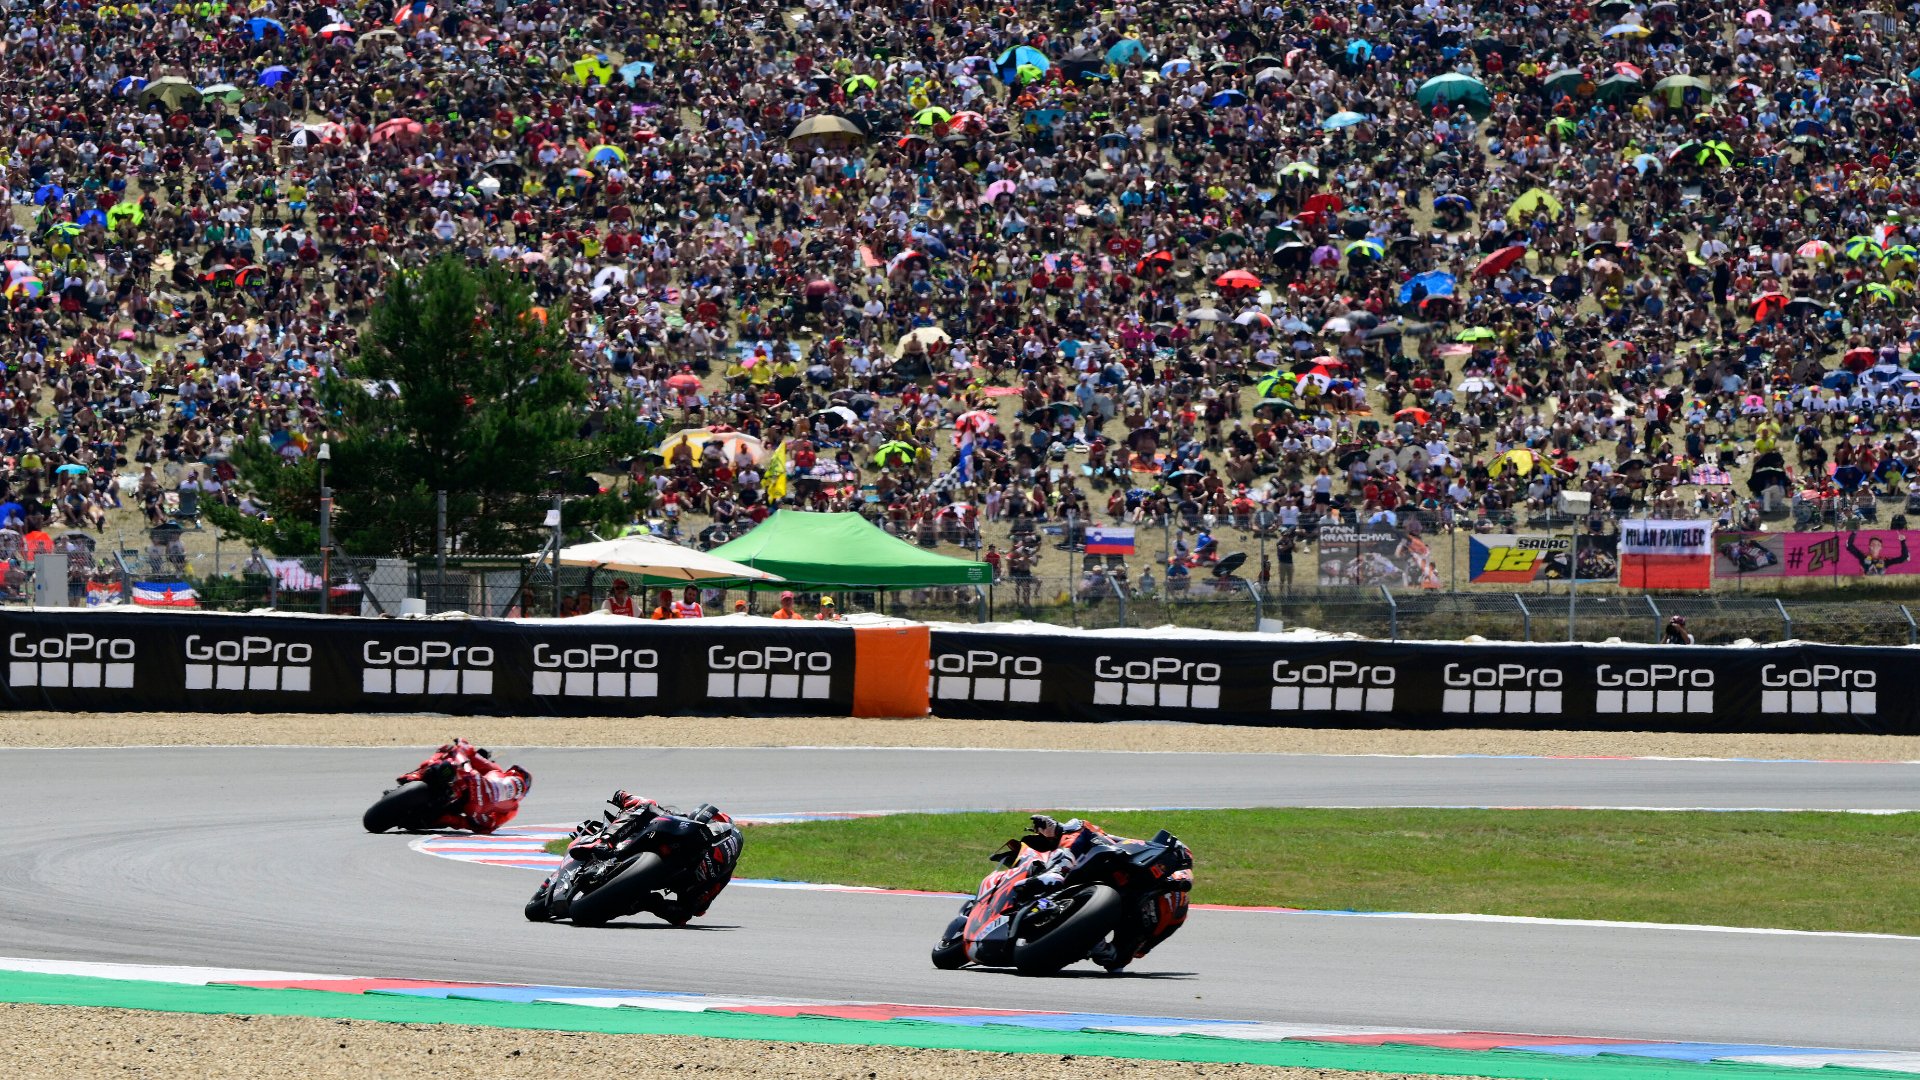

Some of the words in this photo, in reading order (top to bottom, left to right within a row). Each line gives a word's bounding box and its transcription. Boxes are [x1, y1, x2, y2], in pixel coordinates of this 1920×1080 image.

[1320, 525, 1355, 534] FYNN
[1660, 528, 1705, 547] PAWELEC
[1483, 547, 1539, 572] 12
[9, 632, 136, 660] GoPro
[185, 634, 313, 664] GoPro
[363, 640, 494, 667] GoPro
[533, 643, 658, 669] GoPro
[708, 645, 832, 670] GoPro
[929, 650, 1042, 676] oPro
[1095, 655, 1221, 683] GoPro
[1272, 659, 1396, 686] GoPro
[1444, 663, 1563, 687] GoPro
[1596, 664, 1715, 688] GoPro
[1761, 664, 1877, 688] GoPro
